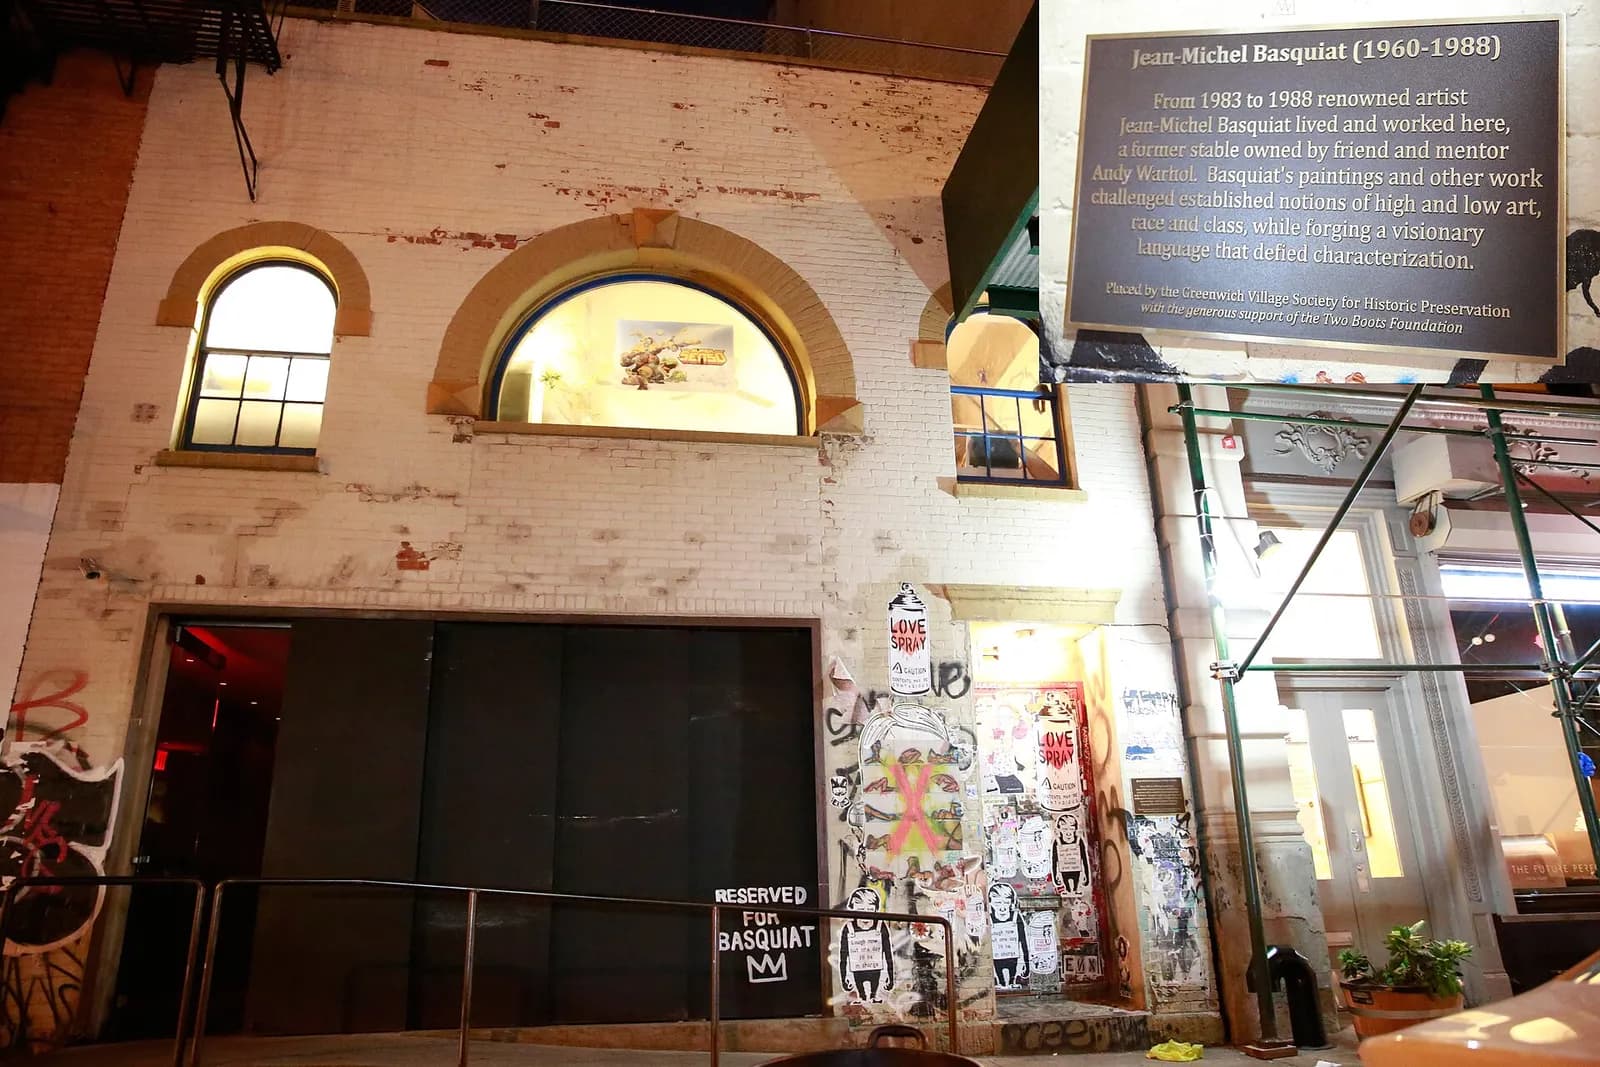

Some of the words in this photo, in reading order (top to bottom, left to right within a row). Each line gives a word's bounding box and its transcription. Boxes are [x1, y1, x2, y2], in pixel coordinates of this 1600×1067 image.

[1131, 45, 1248, 69] Jean-Michel
[1253, 42, 1347, 66] Basquiat
[1353, 35, 1501, 63] (1960-1988)
[1153, 93, 1195, 109] From
[1200, 91, 1242, 109] 1983
[1247, 92, 1263, 108] to
[1269, 90, 1313, 108] 1988
[1318, 88, 1410, 107] renowned
[1416, 88, 1469, 106] artist
[1120, 115, 1212, 136] Jean-Michel
[1218, 116, 1290, 137] Basquiat
[1296, 115, 1338, 133] lived
[1343, 115, 1379, 132] and
[1383, 114, 1454, 132] worked
[1461, 114, 1511, 135] here,
[1119, 145, 1128, 157] a
[1130, 141, 1184, 157] former
[1190, 141, 1239, 158] stable
[1244, 141, 1302, 159] owned
[1308, 141, 1329, 162] by
[1334, 141, 1388, 159] friend
[1394, 141, 1430, 160] and
[1435, 143, 1509, 160] mentor
[1092, 165, 1132, 184] Andy
[1136, 165, 1197, 182] Warhol.
[1207, 166, 1293, 187] Basquiat's
[1299, 168, 1383, 190] paintings
[1388, 168, 1424, 186] and
[1430, 168, 1483, 187] other
[1488, 168, 1543, 188] work
[1091, 189, 1174, 209] challenged
[1179, 190, 1274, 210] established
[1280, 194, 1346, 211] notions
[1352, 193, 1373, 211] of
[1375, 193, 1416, 216] high
[1421, 194, 1457, 214] and
[1464, 194, 1501, 214] low
[1506, 199, 1542, 218] art,
[1131, 216, 1164, 231] race
[1168, 215, 1199, 232] and
[1203, 216, 1248, 236] class,
[1253, 217, 1300, 235] while
[1305, 219, 1371, 242] forging
[1376, 227, 1386, 239] a
[1392, 222, 1485, 246] visionary
[1137, 237, 1210, 262] language
[1215, 240, 1249, 260] that
[1253, 241, 1307, 263] defied
[1313, 244, 1474, 270] characterization.
[1106, 282, 1142, 295] Placed
[1145, 283, 1158, 298] by
[1161, 284, 1179, 297] the
[1182, 286, 1244, 302] Greenwich
[1248, 290, 1289, 306] Village
[1292, 293, 1338, 310] Society
[1342, 295, 1360, 309] for
[1364, 297, 1417, 312] Historic
[1421, 299, 1511, 318] Preservation
[1141, 301, 1164, 314] with
[1167, 302, 1184, 314] the
[1186, 305, 1237, 319] generous
[1239, 308, 1284, 323] support
[1285, 309, 1301, 324] of
[1301, 311, 1319, 324] the
[1323, 313, 1348, 326] Two
[1352, 315, 1386, 329] Boots
[1389, 317, 1464, 334] Foundation
[891, 617, 926, 634] LOVE
[891, 635, 926, 652] SPRAY
[904, 667, 927, 675] CAUTION
[1038, 730, 1073, 747] LOVE
[1039, 750, 1073, 767] SPRAY
[1053, 783, 1076, 791] CAUTION
[1512, 865, 1529, 874] THE
[1533, 865, 1569, 874] FUTURE
[1572, 864, 1596, 873] PERF
[715, 886, 807, 905] RESERVED
[743, 911, 780, 927] FOR
[718, 925, 815, 952] BASQUIAT
